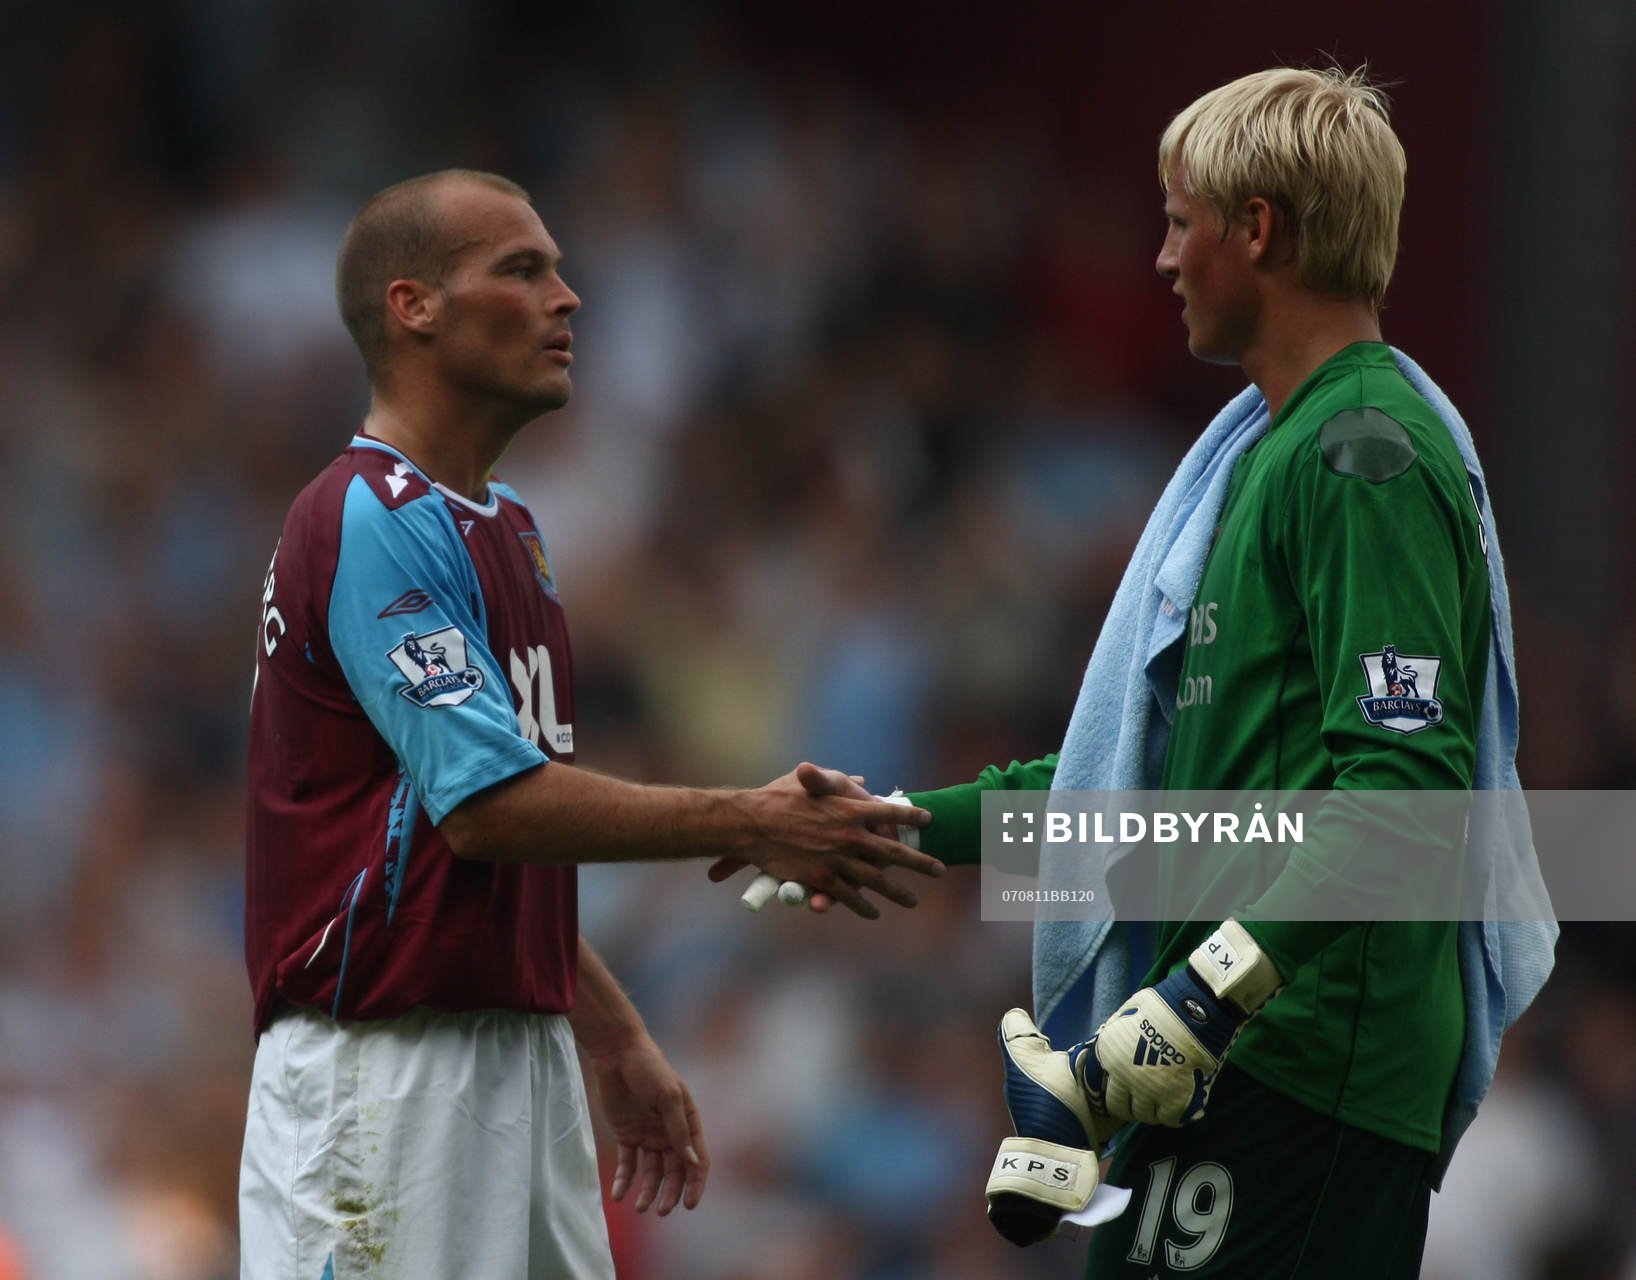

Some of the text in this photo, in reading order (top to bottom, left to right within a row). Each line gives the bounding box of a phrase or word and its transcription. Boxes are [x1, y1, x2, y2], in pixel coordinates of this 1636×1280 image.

[417, 675, 462, 697] BARCLAYS
[1373, 700, 1421, 712] BARCLAYS
[1139, 1019, 1186, 1065] adidas
[1126, 1155, 1234, 1272] 19
